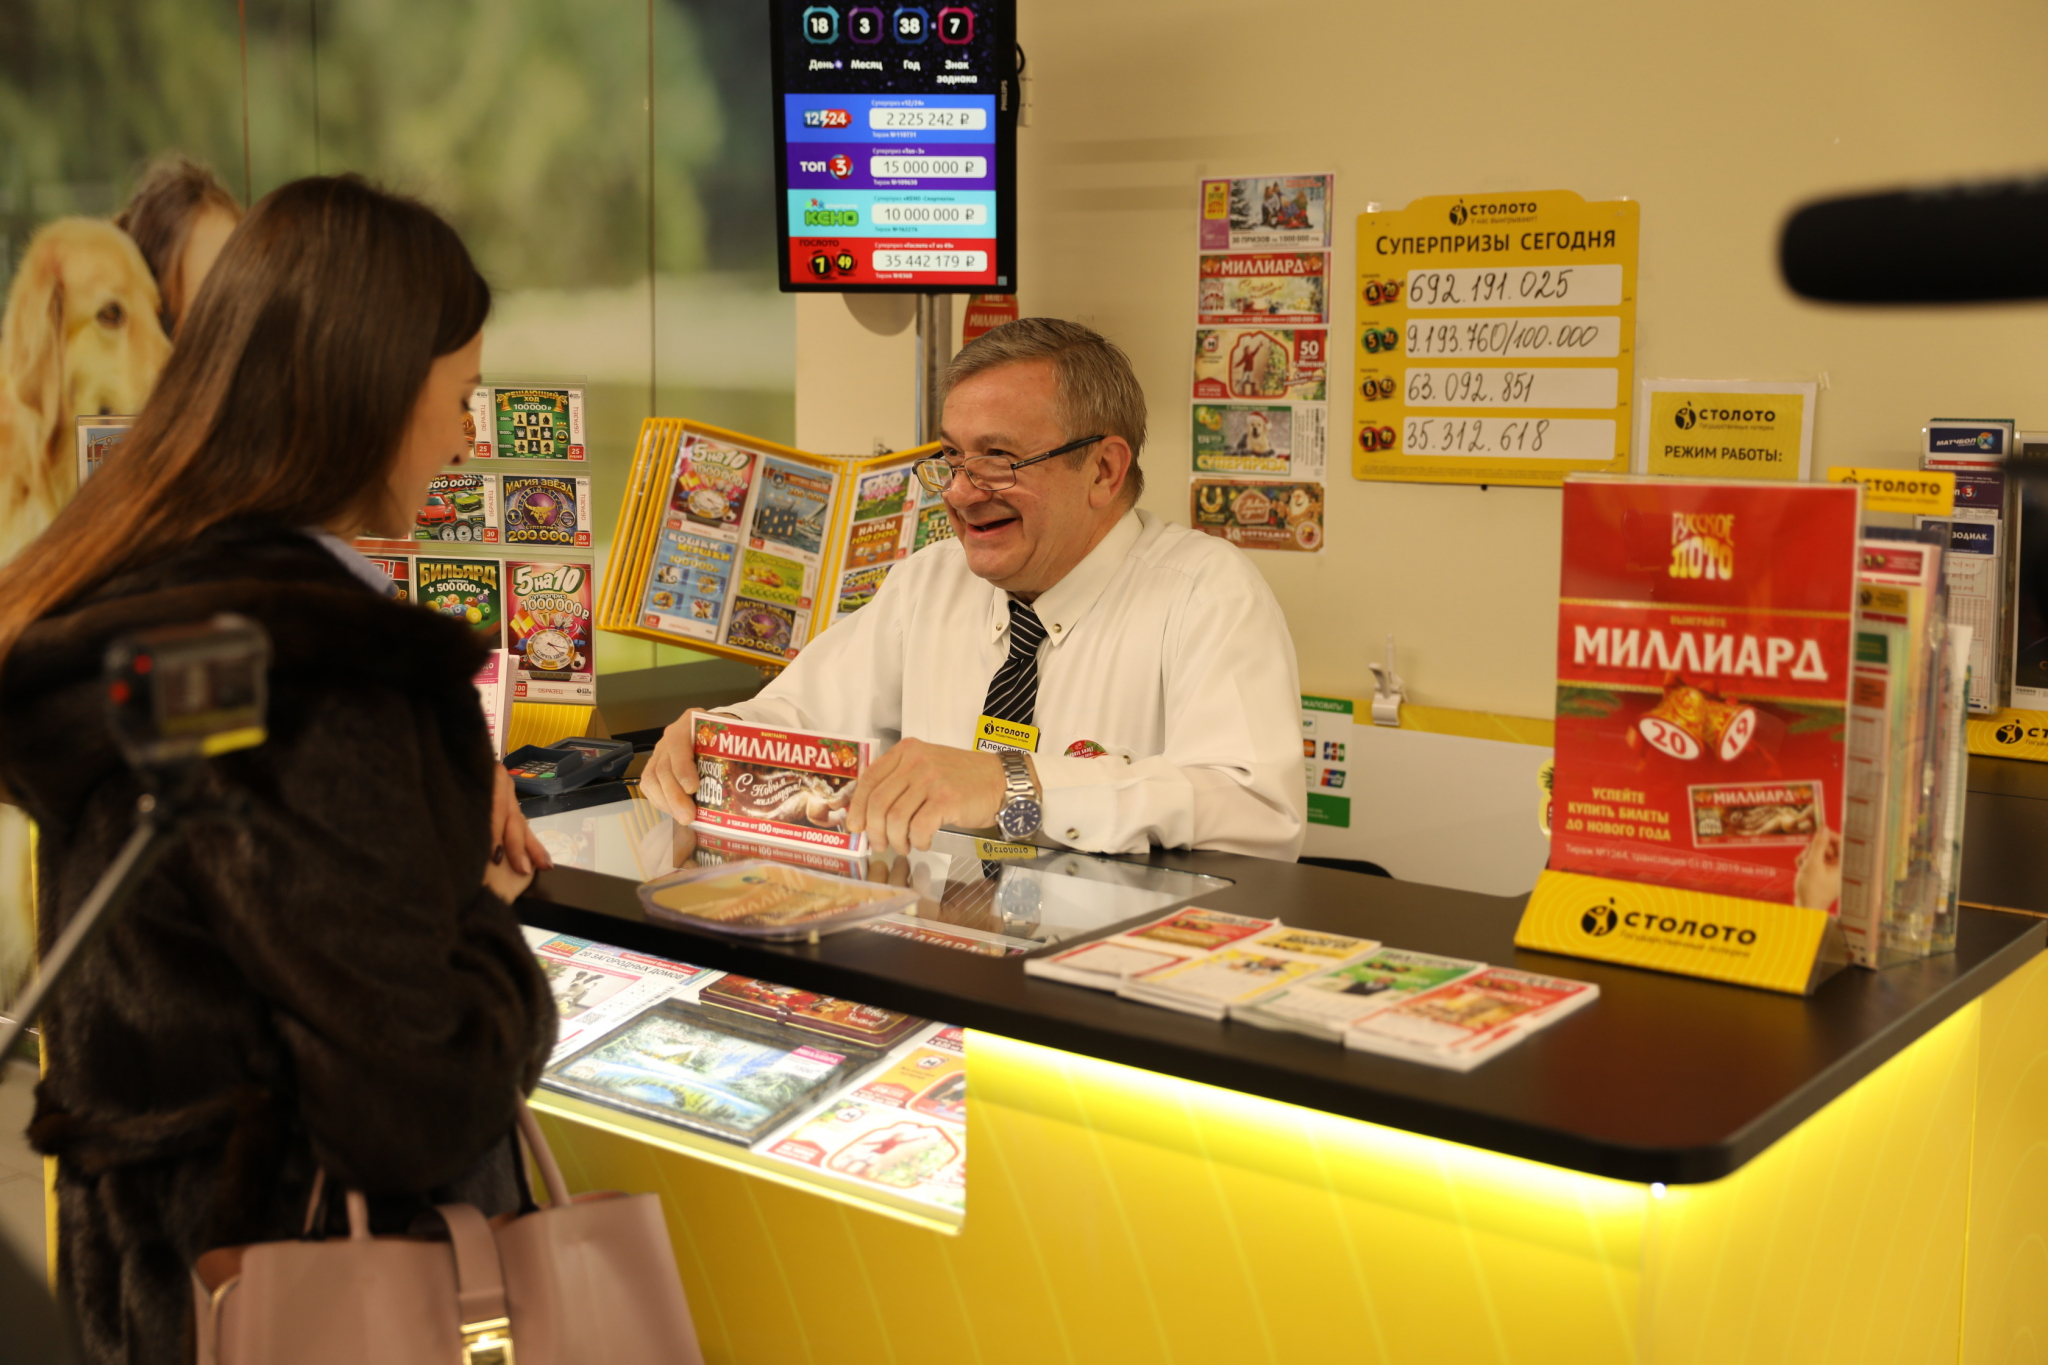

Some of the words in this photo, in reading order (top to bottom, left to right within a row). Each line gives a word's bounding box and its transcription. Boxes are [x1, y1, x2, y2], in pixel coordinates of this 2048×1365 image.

[810, 17, 829, 34] 18
[859, 17, 870, 34] 3
[899, 17, 921, 34] 38
[949, 18, 961, 34] 7
[808, 60, 835, 71] День
[851, 60, 883, 71] Месяц
[903, 60, 921, 71] Год
[944, 60, 970, 70] Знак
[936, 75, 978, 84] зодиака
[805, 112, 819, 125] 12
[830, 112, 847, 125] 24
[887, 112, 894, 126] 2
[898, 112, 924, 126] 225
[928, 112, 954, 126] 242
[800, 161, 826, 172] ТОП
[836, 159, 847, 176] 3
[884, 161, 900, 174] 15
[903, 161, 930, 174] 000
[932, 161, 959, 174] 000
[884, 208, 901, 221] 10
[904, 208, 930, 221] 000
[933, 208, 959, 221] 000
[1470, 202, 1537, 216] СТОЛОТО
[805, 210, 859, 226] КЕНО
[799, 239, 839, 247] ГОСЛОТО
[1376, 233, 1510, 255] СУПЕРПРИЗЫ
[1521, 230, 1616, 252] СЕГОДНЯ
[815, 256, 826, 273] 7
[837, 255, 852, 269] 49
[885, 255, 901, 268] 35
[905, 255, 931, 268] 442
[935, 255, 960, 268] 179
[1220, 258, 1305, 275] МИЛЛИАРД
[1299, 341, 1319, 355] 50
[504, 390, 560, 400] РЕШАЮЩИЙ
[1699, 409, 1776, 422] СТОЛОТО
[1936, 437, 1977, 447] МАТЧБОЛ
[1664, 445, 1717, 459] РЕЖИМ
[1721, 447, 1783, 462] РАБОТЫ:
[1196, 454, 1288, 473] СУПЕРПРИЗА
[505, 478, 539, 496] МАГИЯ
[540, 478, 576, 501] ЗВЁЗД
[1965, 487, 1973, 498] 3
[486, 530, 495, 538] 30
[507, 529, 538, 542] 200
[858, 520, 897, 537] НАРДЫ
[1671, 511, 1736, 548] РУССКОЕ
[1951, 531, 1988, 541] ЗОДИАК
[667, 532, 723, 551] КОШКИ-
[1667, 535, 1734, 581] ЛОТО
[419, 562, 498, 591] БИЛЬЯРД
[436, 583, 457, 593] 500
[735, 599, 766, 612] МАГИЯ
[1573, 624, 1829, 682] МИЛЛИАРД
[1302, 700, 1344, 712] ЖАЛОВАТЬ!
[995, 725, 1031, 739] СТОЛОТО
[1651, 721, 1688, 756] 20
[1726, 716, 1750, 753] 19
[718, 732, 833, 770] МИЛЛИАРД
[735, 772, 754, 793] С
[750, 778, 787, 798] Новым
[1591, 786, 1646, 805] УСПЕЙТЕ
[1712, 789, 1796, 805] МИЛЛИАРД
[1567, 801, 1616, 818] КУПИТЬ
[1618, 806, 1670, 824] БИЛЕТЫ
[731, 819, 749, 829] также
[758, 822, 772, 834] 100
[772, 826, 793, 837] призов
[1565, 818, 1584, 831] ДО
[1586, 820, 1636, 838] НОВОГО
[1638, 826, 1672, 842] ГОДА
[1623, 911, 1757, 946] СТОЛОТО
[589, 952, 650, 973] ЗАГОРОДНЫХ
[648, 967, 686, 981] ДОМОВ
